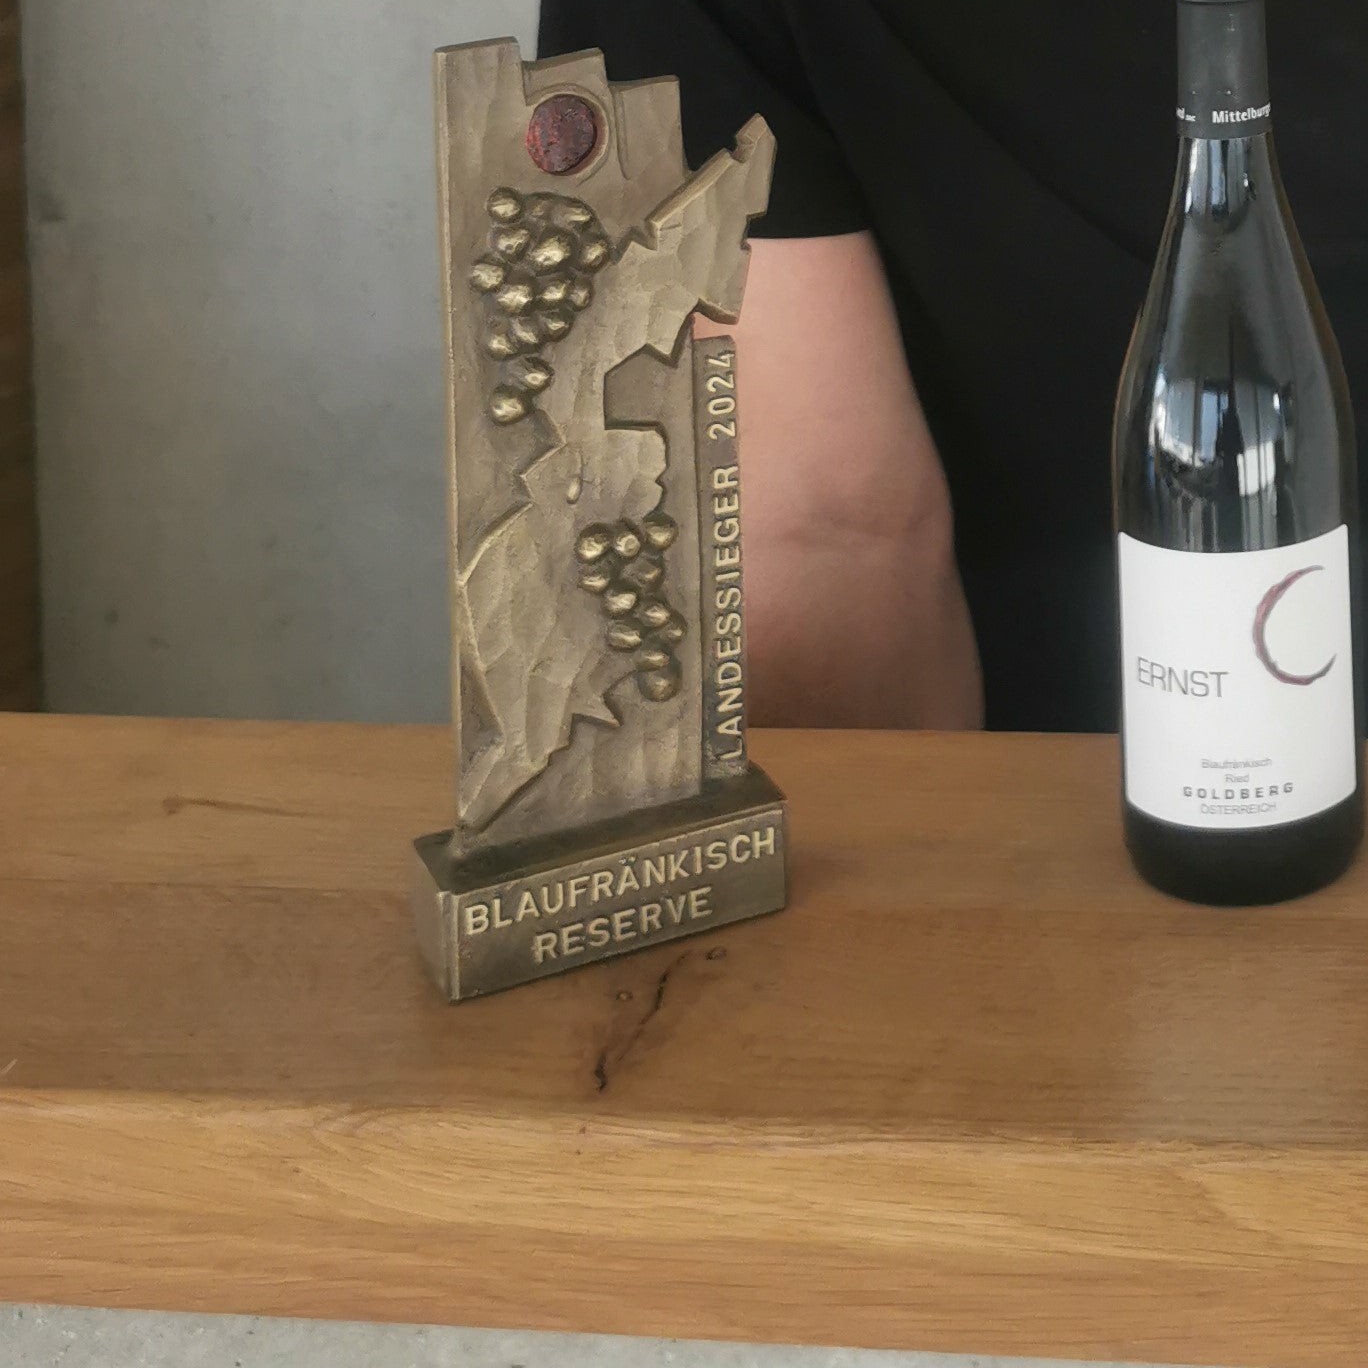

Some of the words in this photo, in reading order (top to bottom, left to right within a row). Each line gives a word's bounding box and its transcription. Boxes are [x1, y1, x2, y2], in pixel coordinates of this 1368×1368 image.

[706, 349, 737, 441] 2024
[713, 465, 744, 762] LANDESSIEGER
[1137, 656, 1229, 698] ERNST
[1182, 782, 1294, 800] GOLDBERG
[464, 827, 776, 936] BLAUFRÄNKISCH
[532, 886, 713, 965] RESERVE
